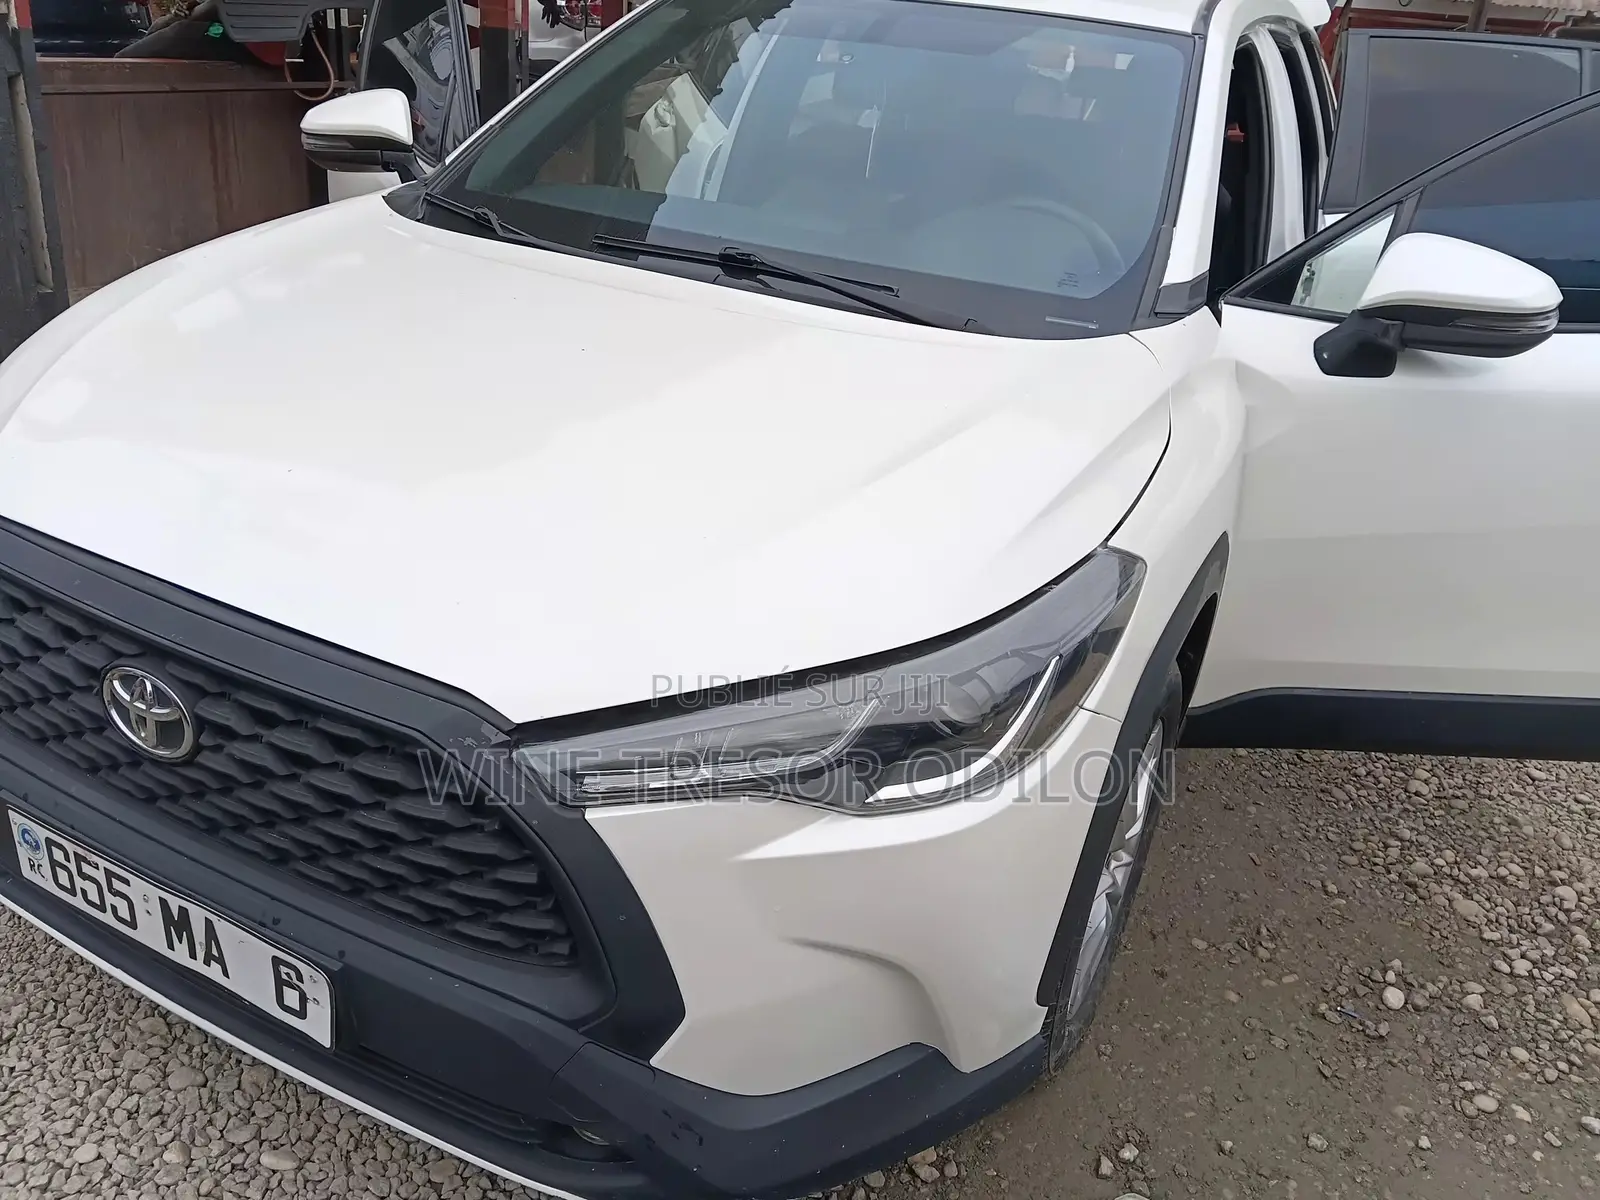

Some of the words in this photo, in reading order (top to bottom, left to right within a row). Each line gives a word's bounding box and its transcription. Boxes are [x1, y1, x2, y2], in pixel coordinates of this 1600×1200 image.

[45, 836, 138, 931] 655
[158, 896, 230, 980] MA
[271, 955, 307, 1020] 6
